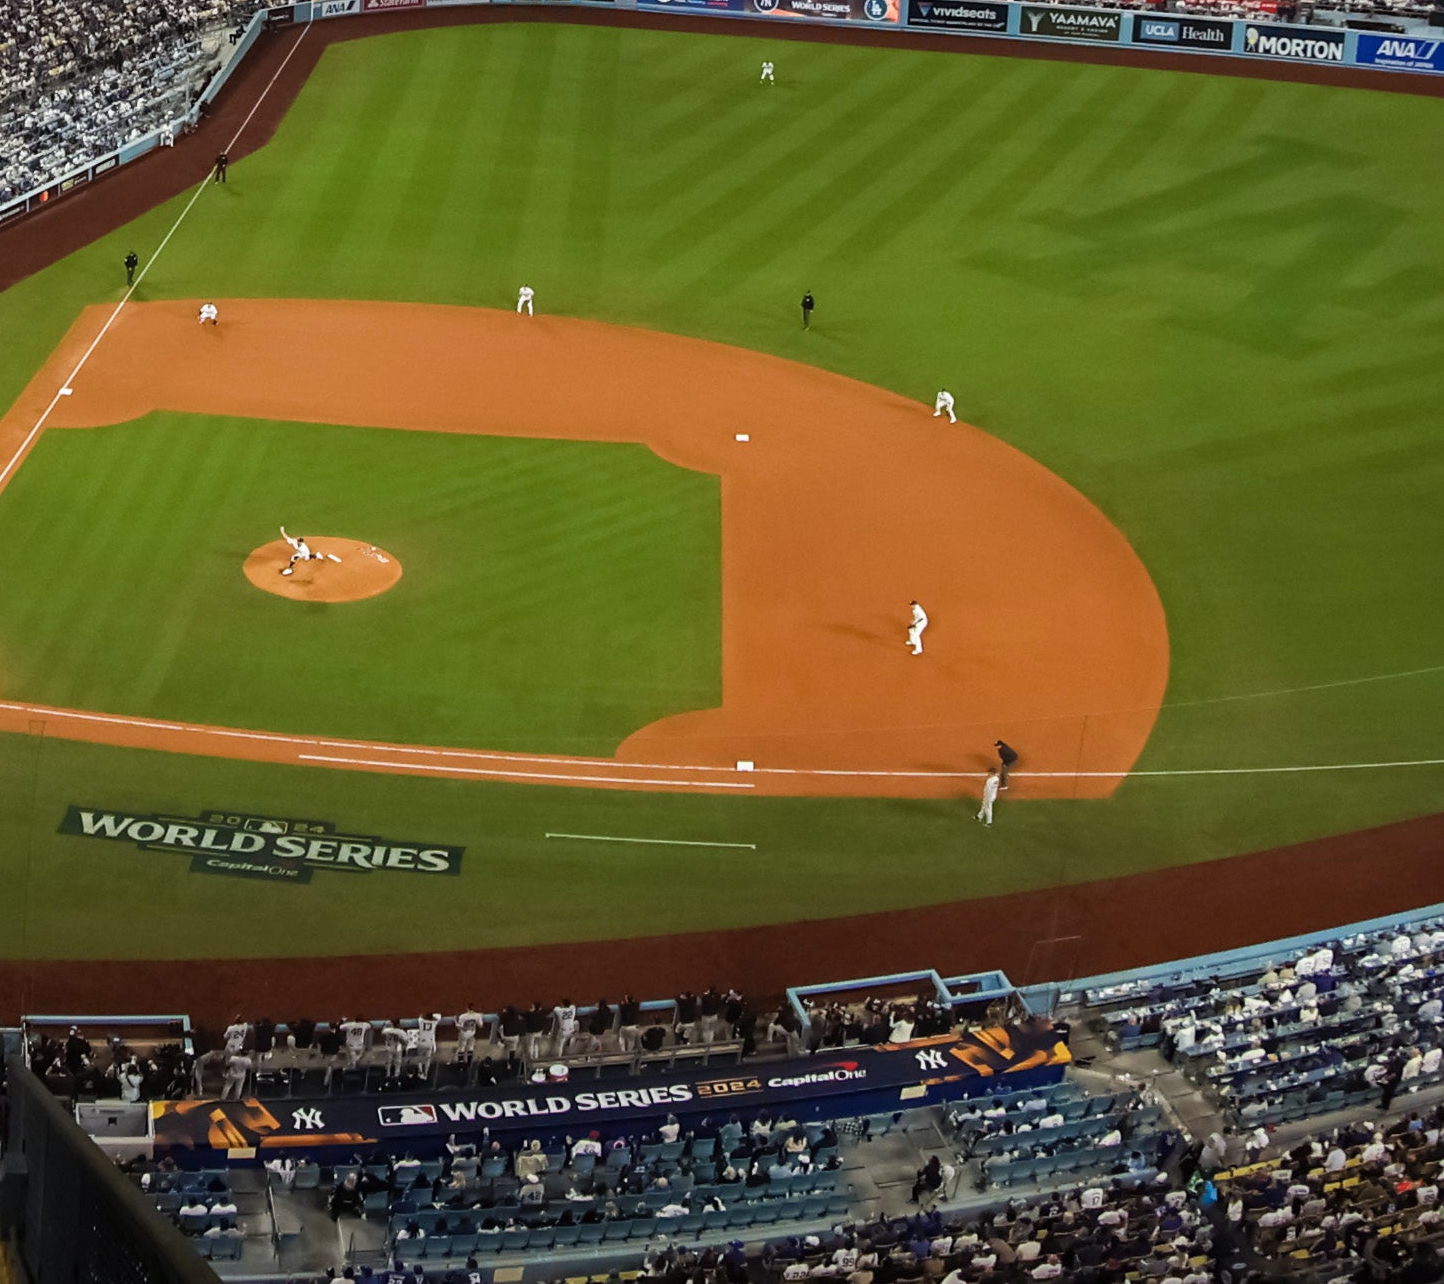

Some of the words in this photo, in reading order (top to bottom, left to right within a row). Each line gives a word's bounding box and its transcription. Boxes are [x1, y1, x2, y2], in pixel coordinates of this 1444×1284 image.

[325, 4, 346, 15] ANA
[791, 0, 822, 11] WORLD
[822, 2, 850, 13] SERIES
[933, 6, 996, 20] vividseats
[1145, 24, 1174, 38] UCLA
[1182, 26, 1224, 42] Health
[1259, 36, 1343, 62] MORTON
[1376, 40, 1414, 58] ANA
[78, 811, 267, 855] WORLD
[272, 836, 451, 871] SERIES
[915, 1047, 949, 1071] NY
[439, 1094, 571, 1122] WORLD
[576, 1084, 693, 1114] SERIES
[698, 1078, 761, 1096] 2024
[292, 1107, 324, 1130] NY
